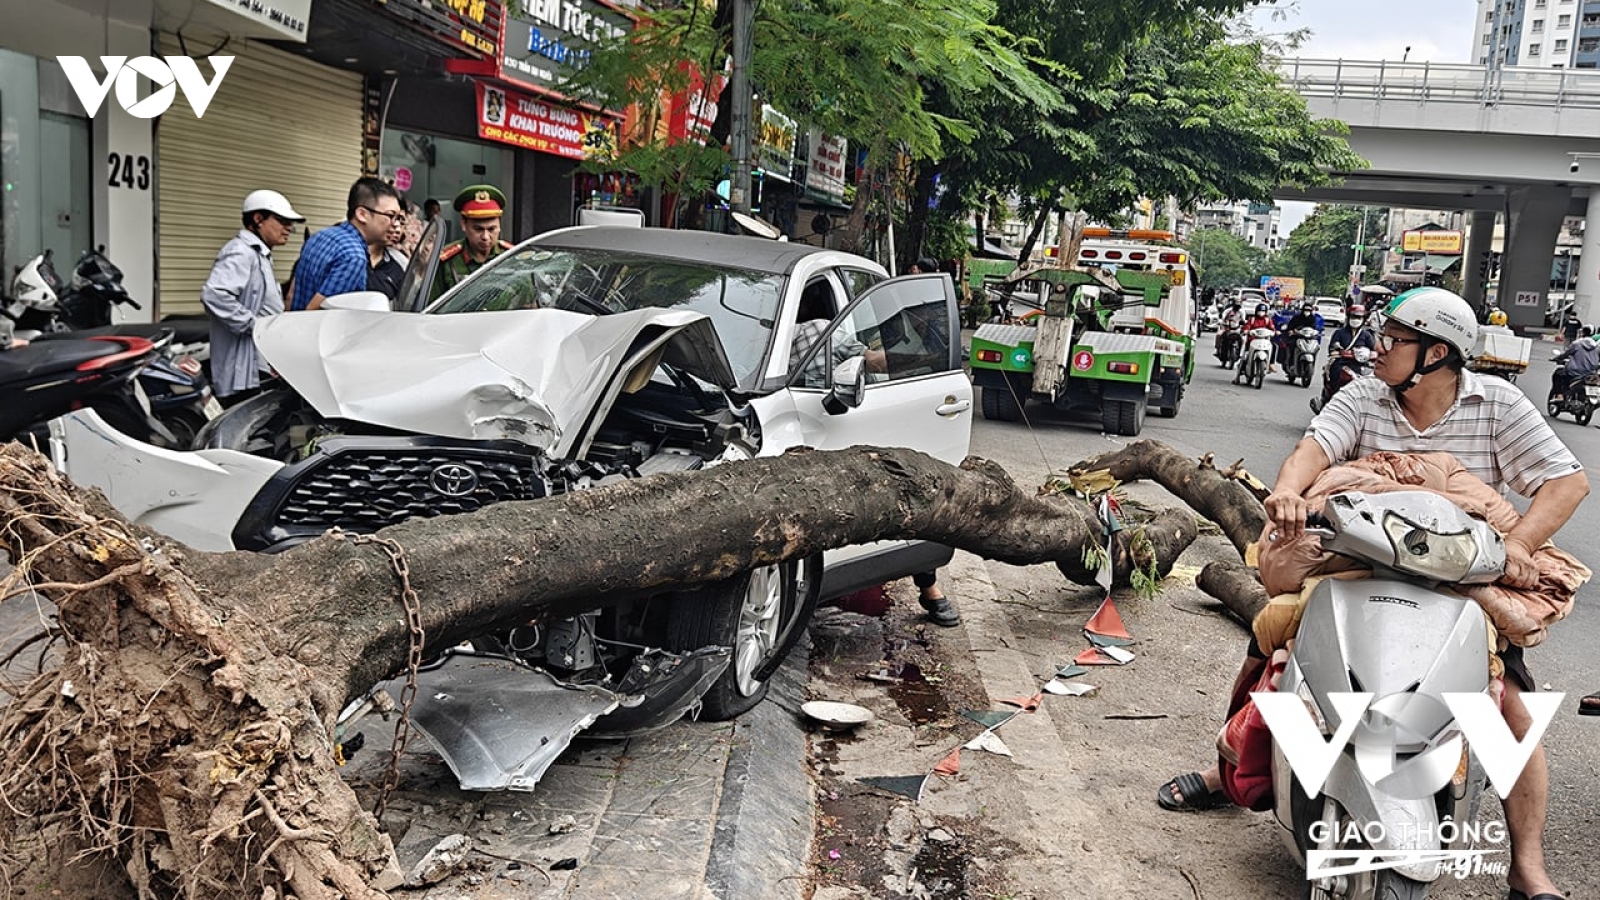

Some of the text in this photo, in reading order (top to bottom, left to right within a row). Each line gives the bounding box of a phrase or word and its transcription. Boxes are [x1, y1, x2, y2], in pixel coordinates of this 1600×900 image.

[510, 113, 537, 133] KHAI
[485, 126, 502, 137] CHO
[503, 129, 520, 142] CÁC
[107, 152, 150, 190] 243
[1518, 294, 1537, 304] P51
